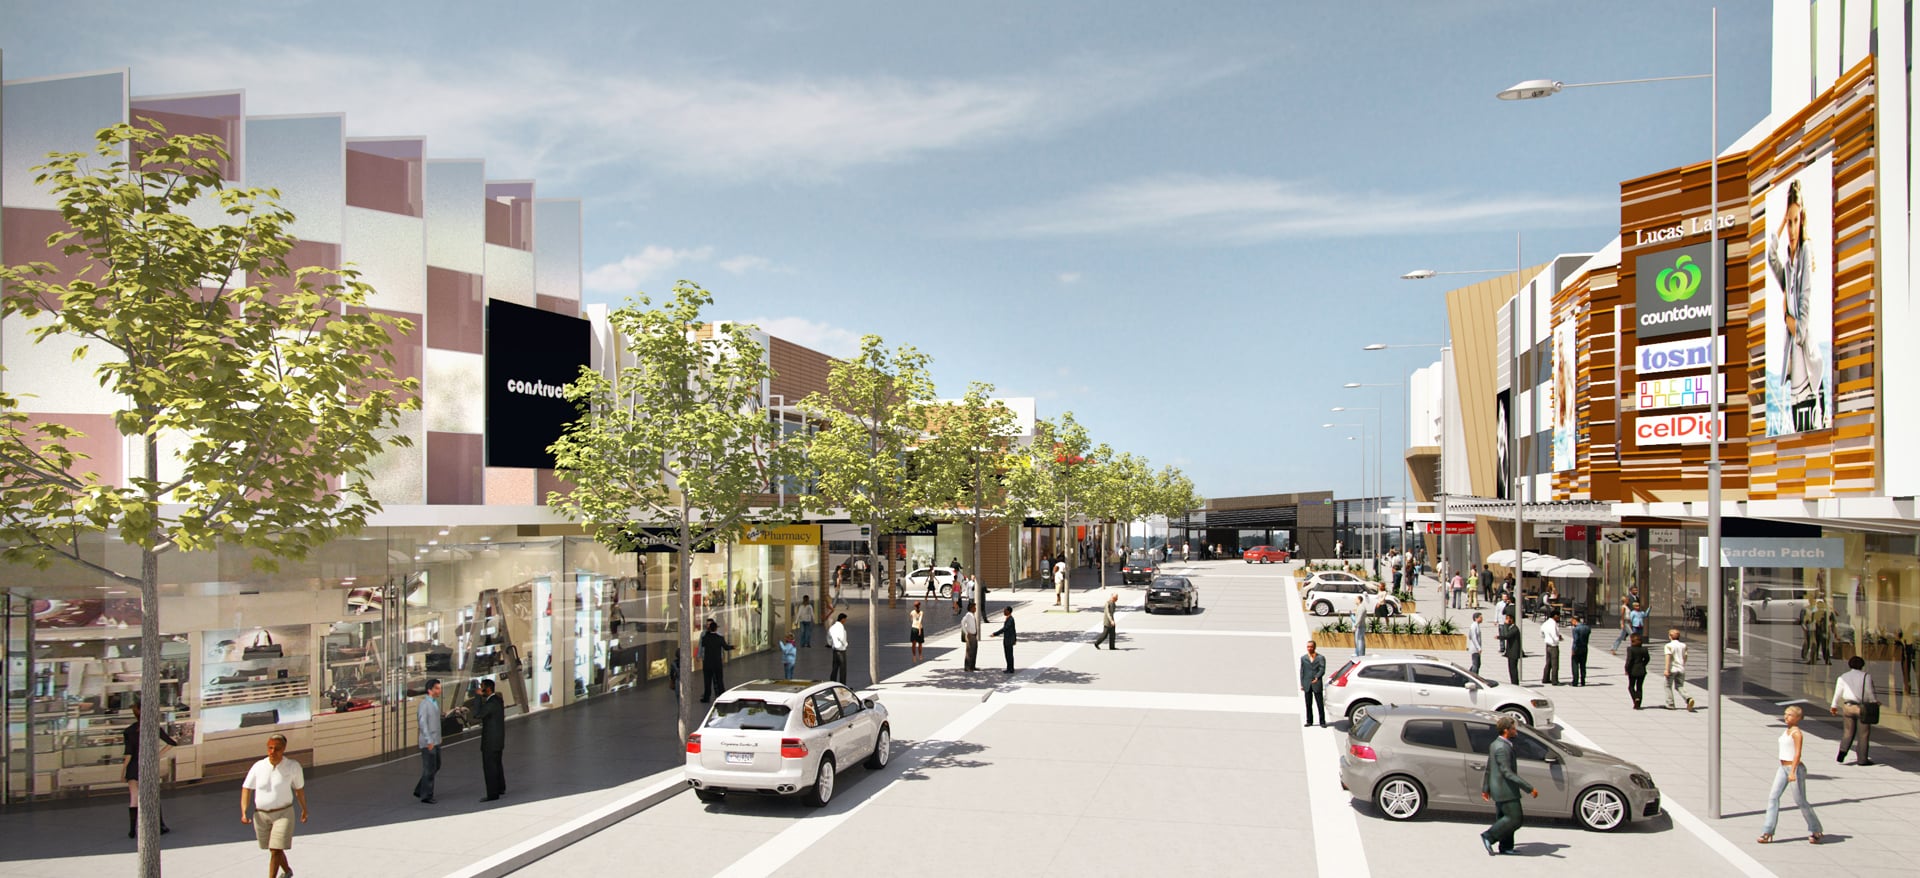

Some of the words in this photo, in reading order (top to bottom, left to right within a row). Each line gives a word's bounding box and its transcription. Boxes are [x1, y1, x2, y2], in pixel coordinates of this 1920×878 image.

[1635, 224, 1684, 247] Lucas
[1690, 213, 1736, 235] Lane
[1637, 415, 1722, 440] celDig
[764, 530, 811, 543] Pharmacy
[1721, 547, 1776, 558] Garden
[1781, 547, 1825, 558] Patch
